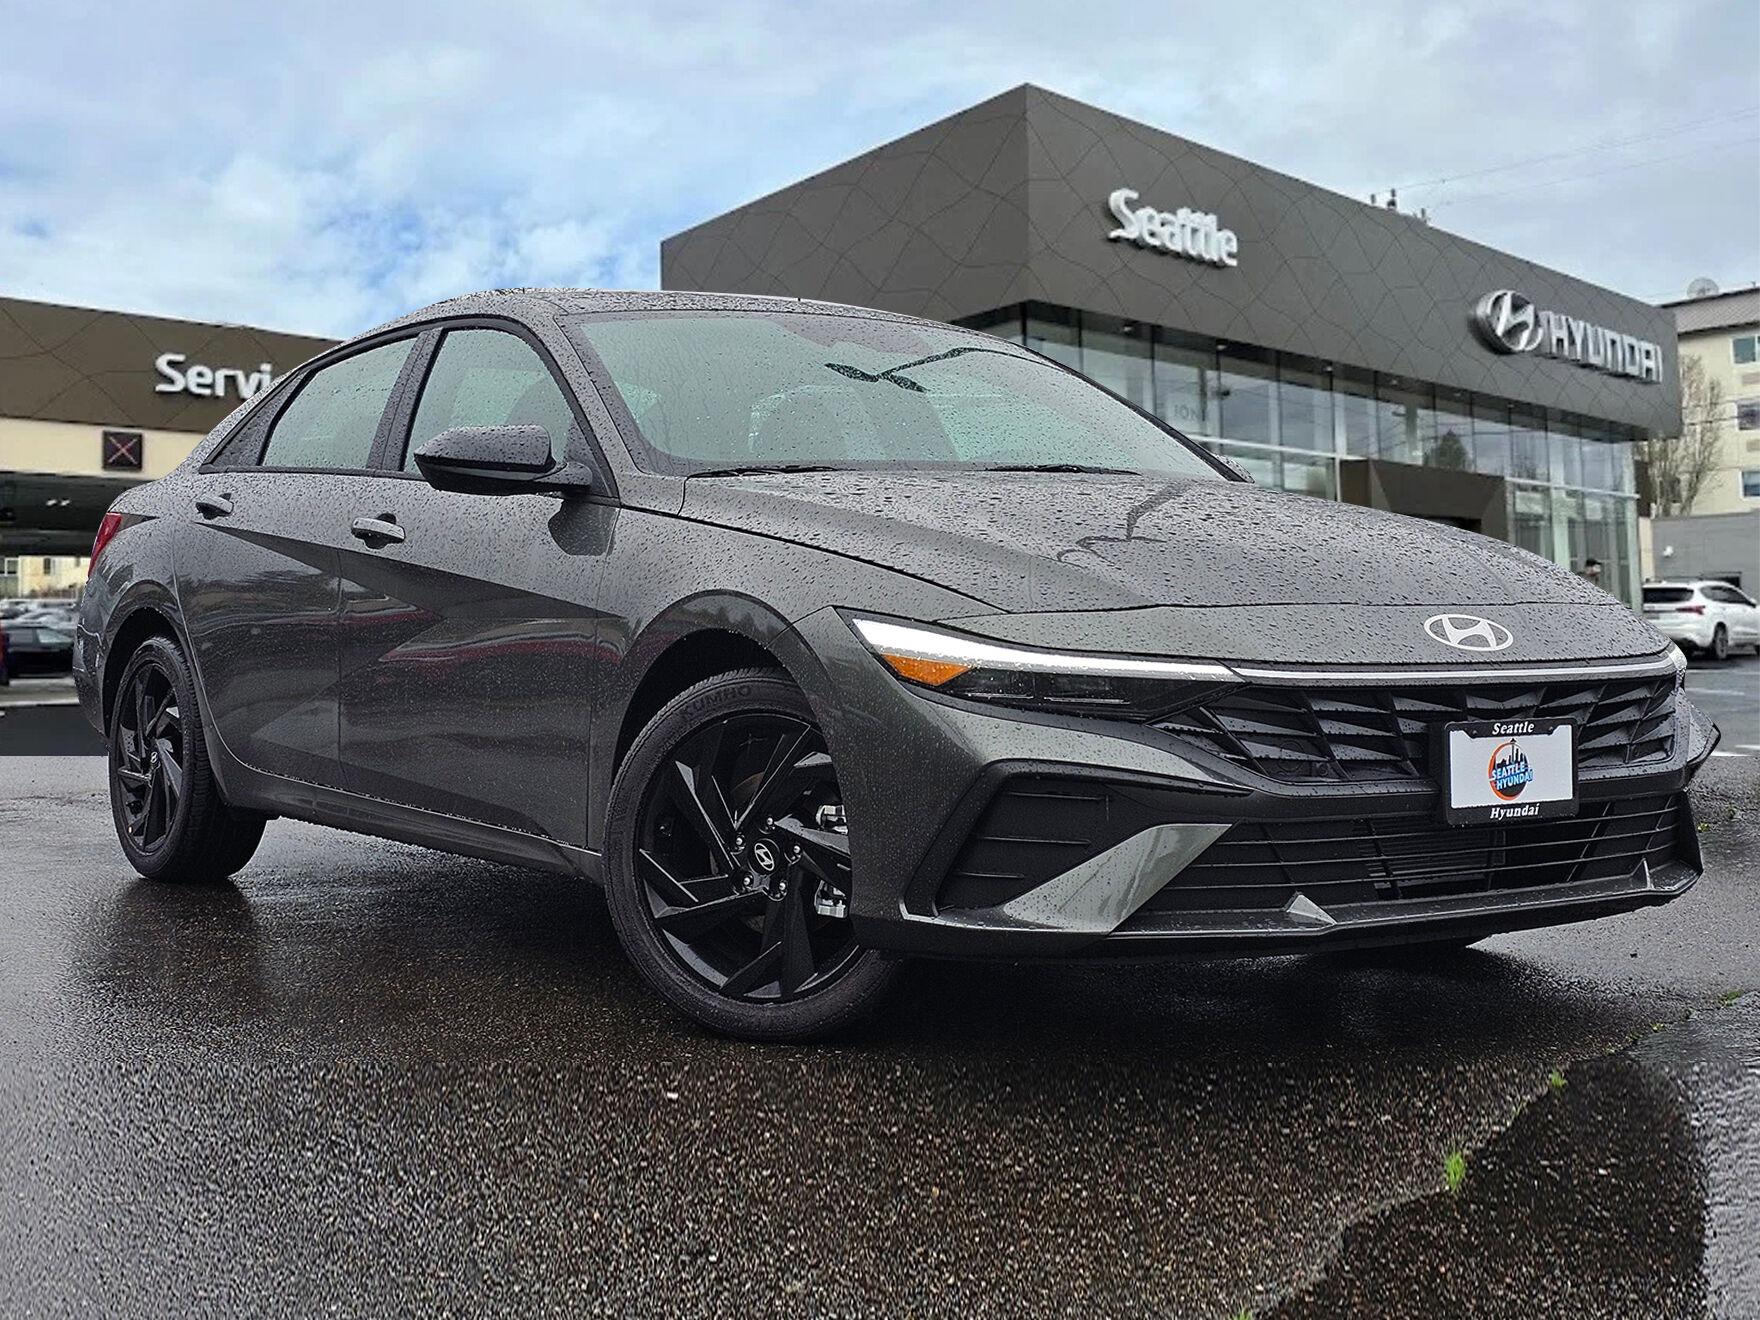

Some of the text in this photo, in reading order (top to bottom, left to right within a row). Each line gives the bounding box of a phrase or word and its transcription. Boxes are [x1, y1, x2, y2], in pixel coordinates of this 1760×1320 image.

[1109, 188, 1238, 266] Seattle
[1540, 311, 1663, 382] HYUNDAI
[1492, 721, 1534, 735] Seattle
[1491, 762, 1525, 780] SEATTLE
[1496, 768, 1533, 790] HYUNDAI
[1490, 803, 1540, 820] Hyundai
